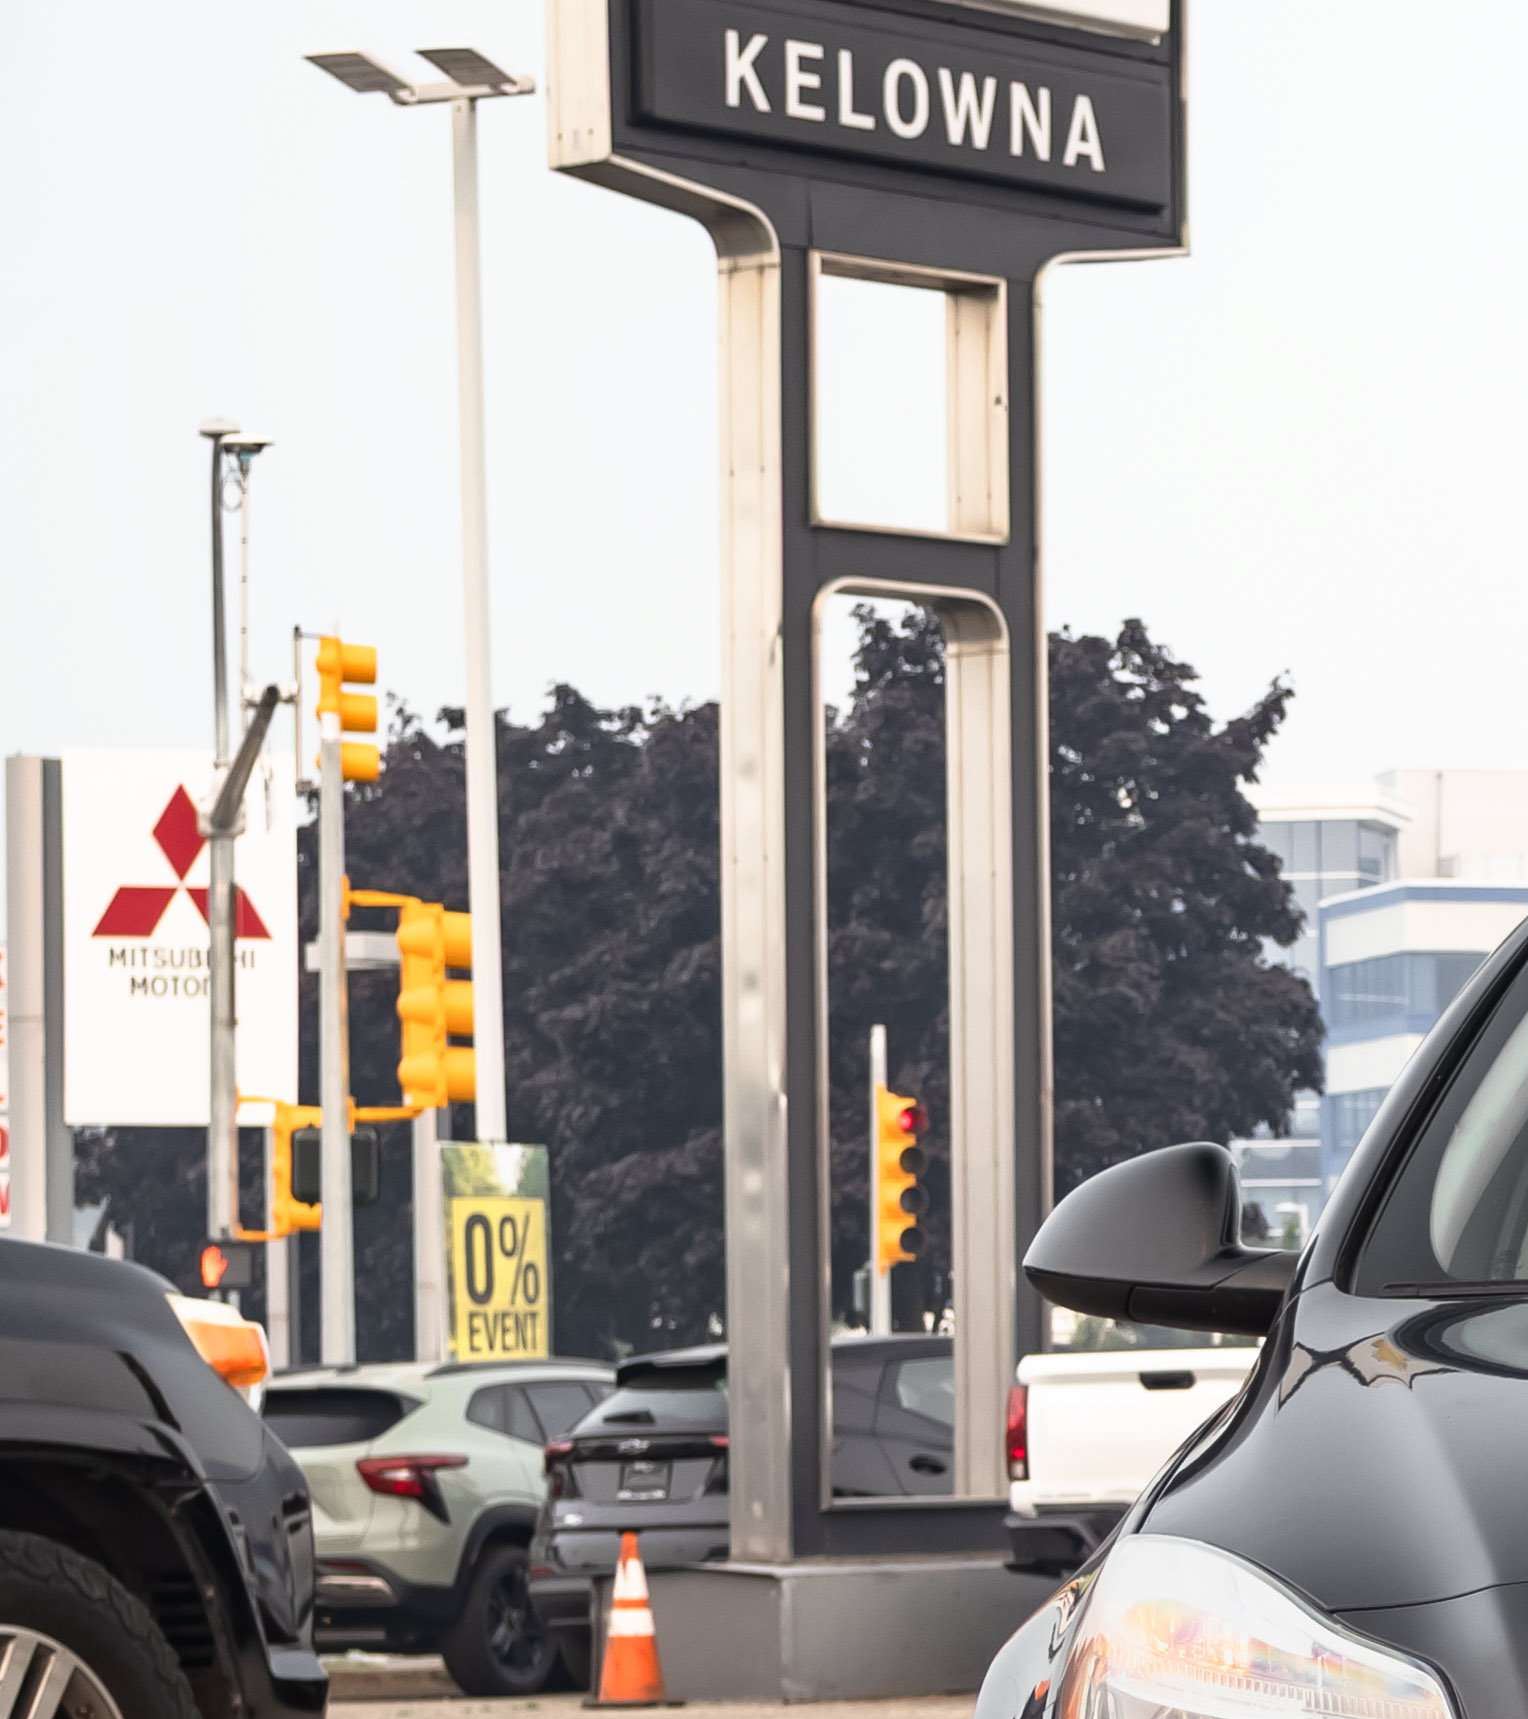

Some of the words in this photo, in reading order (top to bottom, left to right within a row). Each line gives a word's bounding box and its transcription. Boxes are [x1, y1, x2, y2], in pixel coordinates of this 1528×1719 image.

[724, 29, 1106, 172] KELOWNA
[465, 1211, 541, 1306] 0%
[468, 1311, 539, 1352] EVENT
